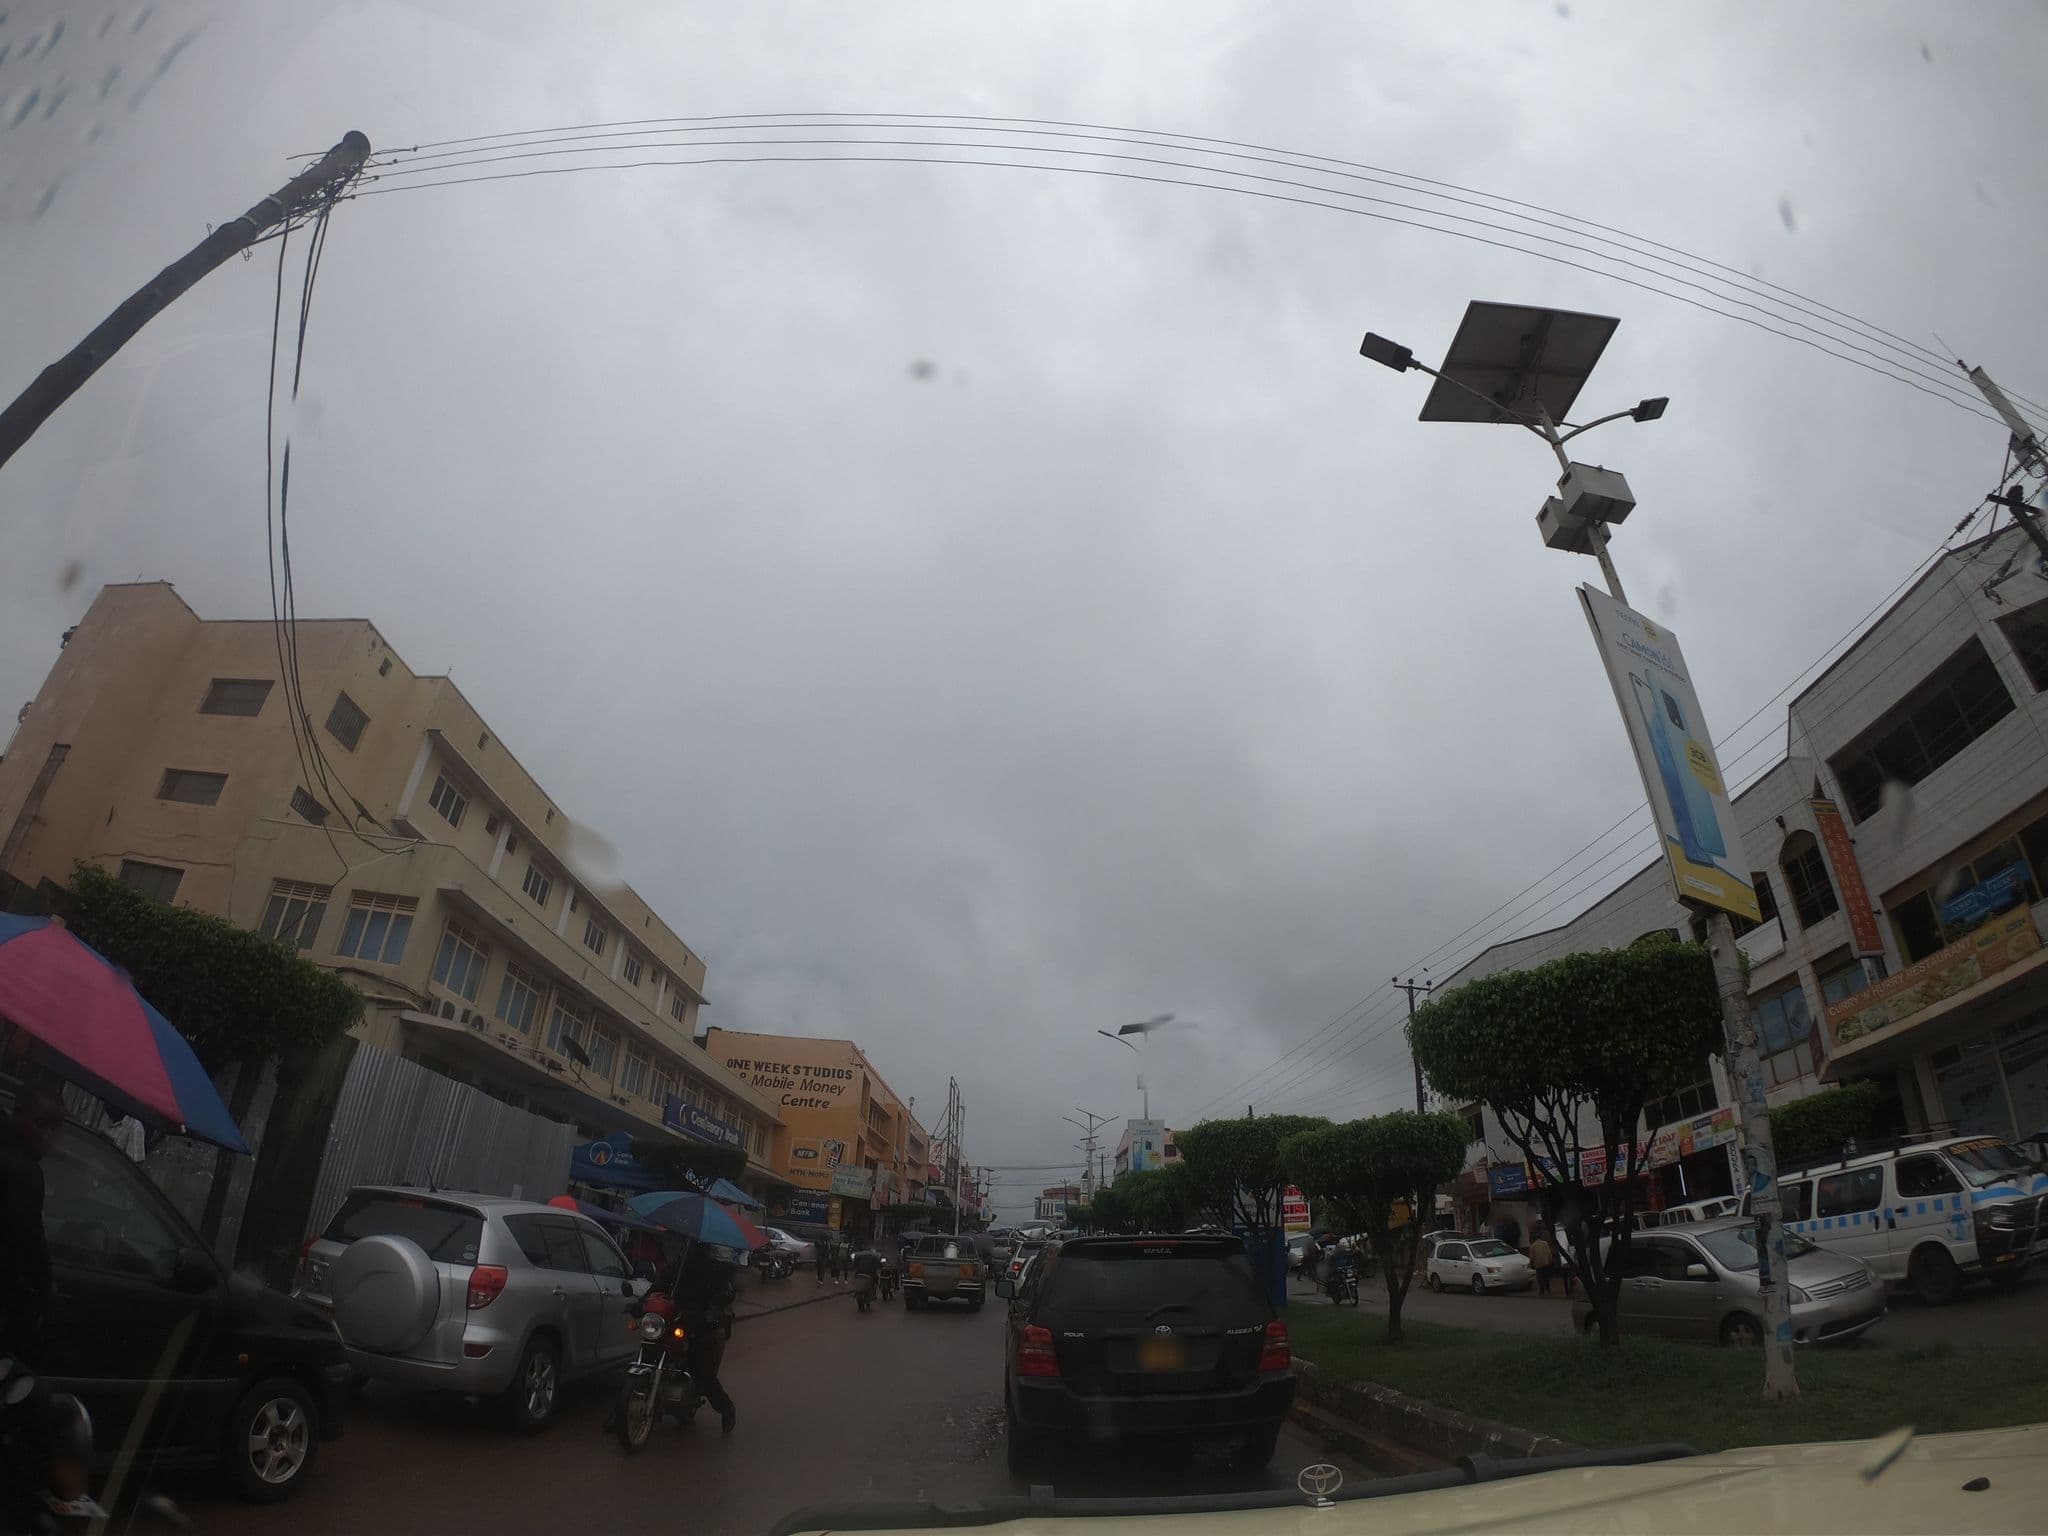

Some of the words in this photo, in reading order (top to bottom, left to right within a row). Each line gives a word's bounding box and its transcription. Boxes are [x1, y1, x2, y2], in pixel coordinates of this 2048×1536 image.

[1828, 998, 1858, 1016] CURRY
[1872, 972, 1904, 995] HURRY
[1906, 939, 1971, 979] RESTAURANT
[726, 1058, 751, 1070] ONE
[754, 1060, 790, 1075] WEEK
[793, 1064, 853, 1080] STUDIOS
[751, 1075, 794, 1090] Mobile
[800, 1078, 846, 1097] Money
[781, 1094, 830, 1109] Centre
[691, 1111, 724, 1141] Centenary
[796, 1149, 815, 1159] MTN
[790, 1207, 811, 1216] Bank
